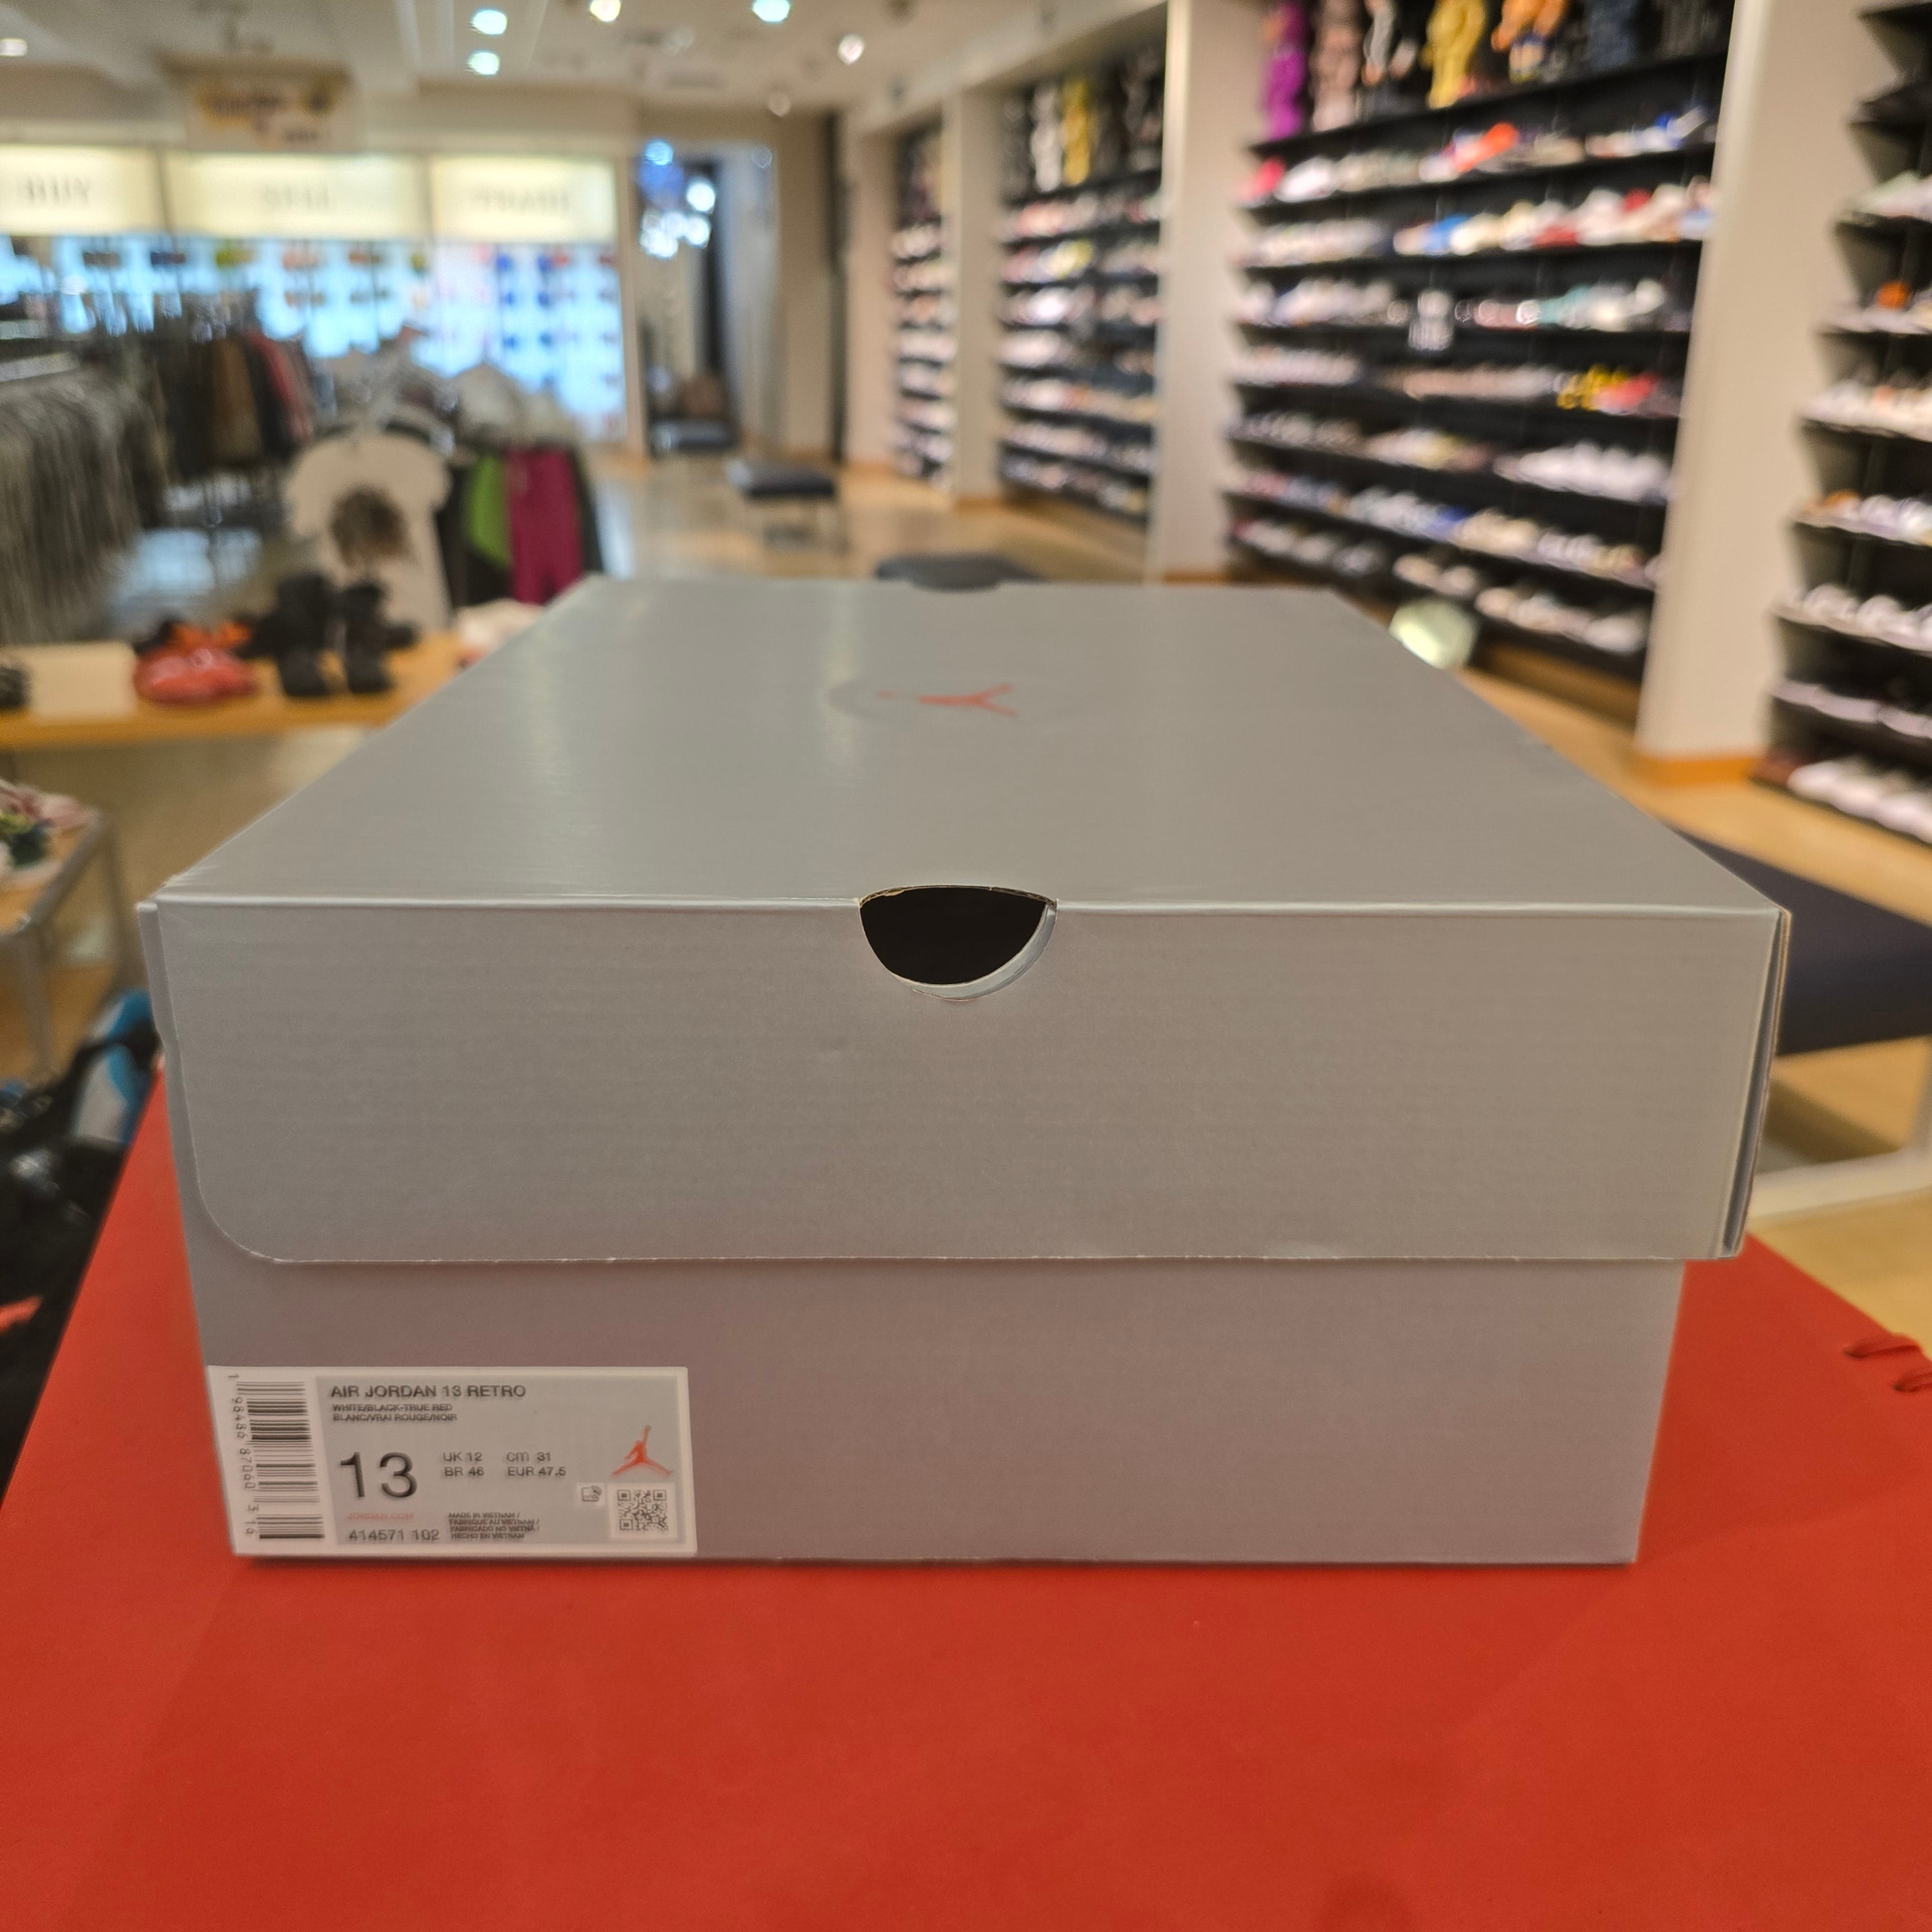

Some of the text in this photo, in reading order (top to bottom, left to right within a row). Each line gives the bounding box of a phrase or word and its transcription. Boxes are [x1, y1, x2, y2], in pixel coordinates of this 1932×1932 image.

[331, 1385, 527, 1398] AIR JORDAN 13 RETRO
[332, 1403, 453, 1412] WHITE/BLACK-TRUE RED
[333, 1413, 458, 1421] BLANC/VRAI ROUGE/NOIR
[443, 1452, 483, 1462] UK 12
[537, 1452, 551, 1462] 31
[239, 1448, 256, 1490] 87060
[340, 1451, 418, 1498] 13
[444, 1466, 484, 1477] BR 46
[507, 1466, 566, 1477] EUR 47.5
[349, 1528, 440, 1541] 414571 102
